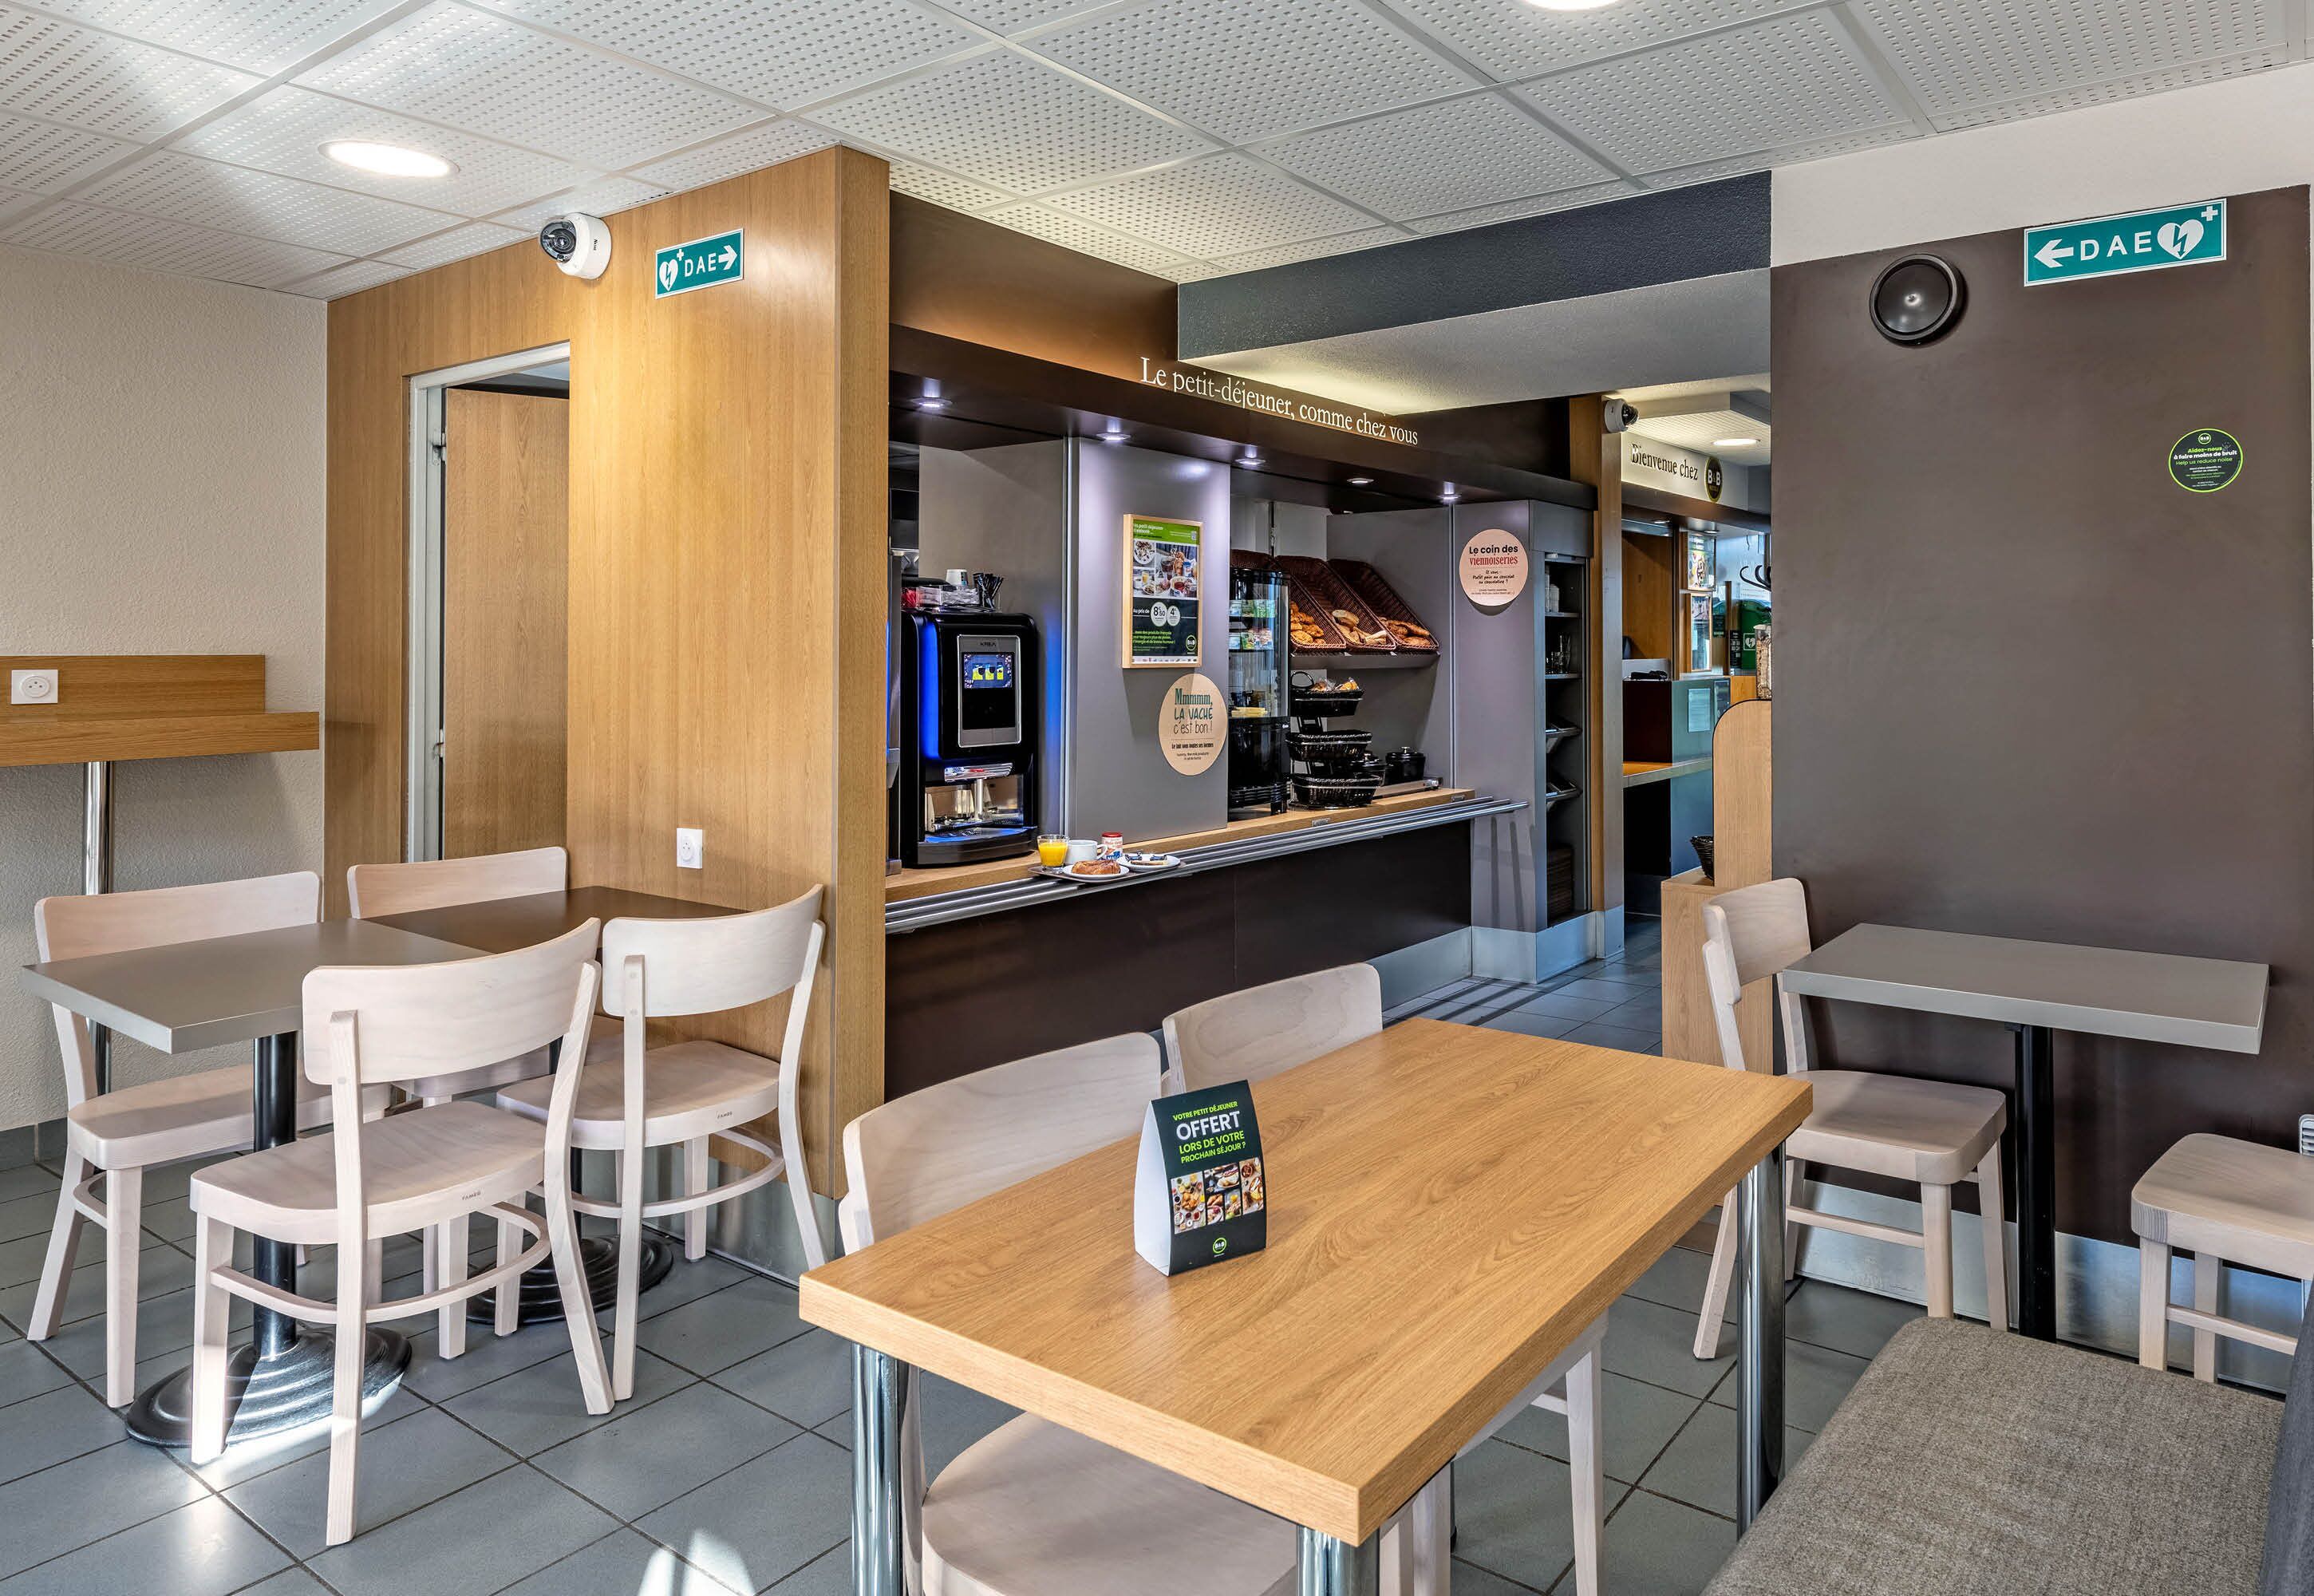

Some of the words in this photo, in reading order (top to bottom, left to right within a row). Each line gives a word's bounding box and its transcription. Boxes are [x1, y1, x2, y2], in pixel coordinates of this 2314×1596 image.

[2079, 231, 2152, 261] DAE
[684, 252, 717, 278] DAE
[1140, 357, 1167, 386] Le
[1172, 371, 1295, 421] petit-déjeuner,
[1299, 404, 1353, 430] comme
[1356, 413, 1386, 438] chez
[1389, 425, 1418, 445] vous
[1630, 444, 1677, 475] Bienvenue
[1679, 459, 1699, 480] chez
[1708, 468, 1721, 486] B&B
[1480, 544, 1500, 553] coin
[1502, 544, 1518, 553] des
[1469, 553, 1518, 566] viennoiseries
[1174, 708, 1185, 721] LA
[1188, 707, 1213, 720] VACHE
[1173, 721, 1193, 734] c'est
[1195, 721, 1208, 733] bon
[1210, 721, 1213, 732] !
[1173, 1111, 1193, 1121] VOTRE
[1193, 1107, 1209, 1116] PETIT
[1209, 1100, 1238, 1113] DÉJEUNER
[1176, 1110, 1240, 1140] OFFERT
[1179, 1140, 1202, 1155] LORS
[1202, 1137, 1215, 1148] DE
[1216, 1130, 1245, 1145] VOTRE
[1181, 1149, 1216, 1163] PROCHAIN
[1216, 1143, 1242, 1156] SÉJOUR
